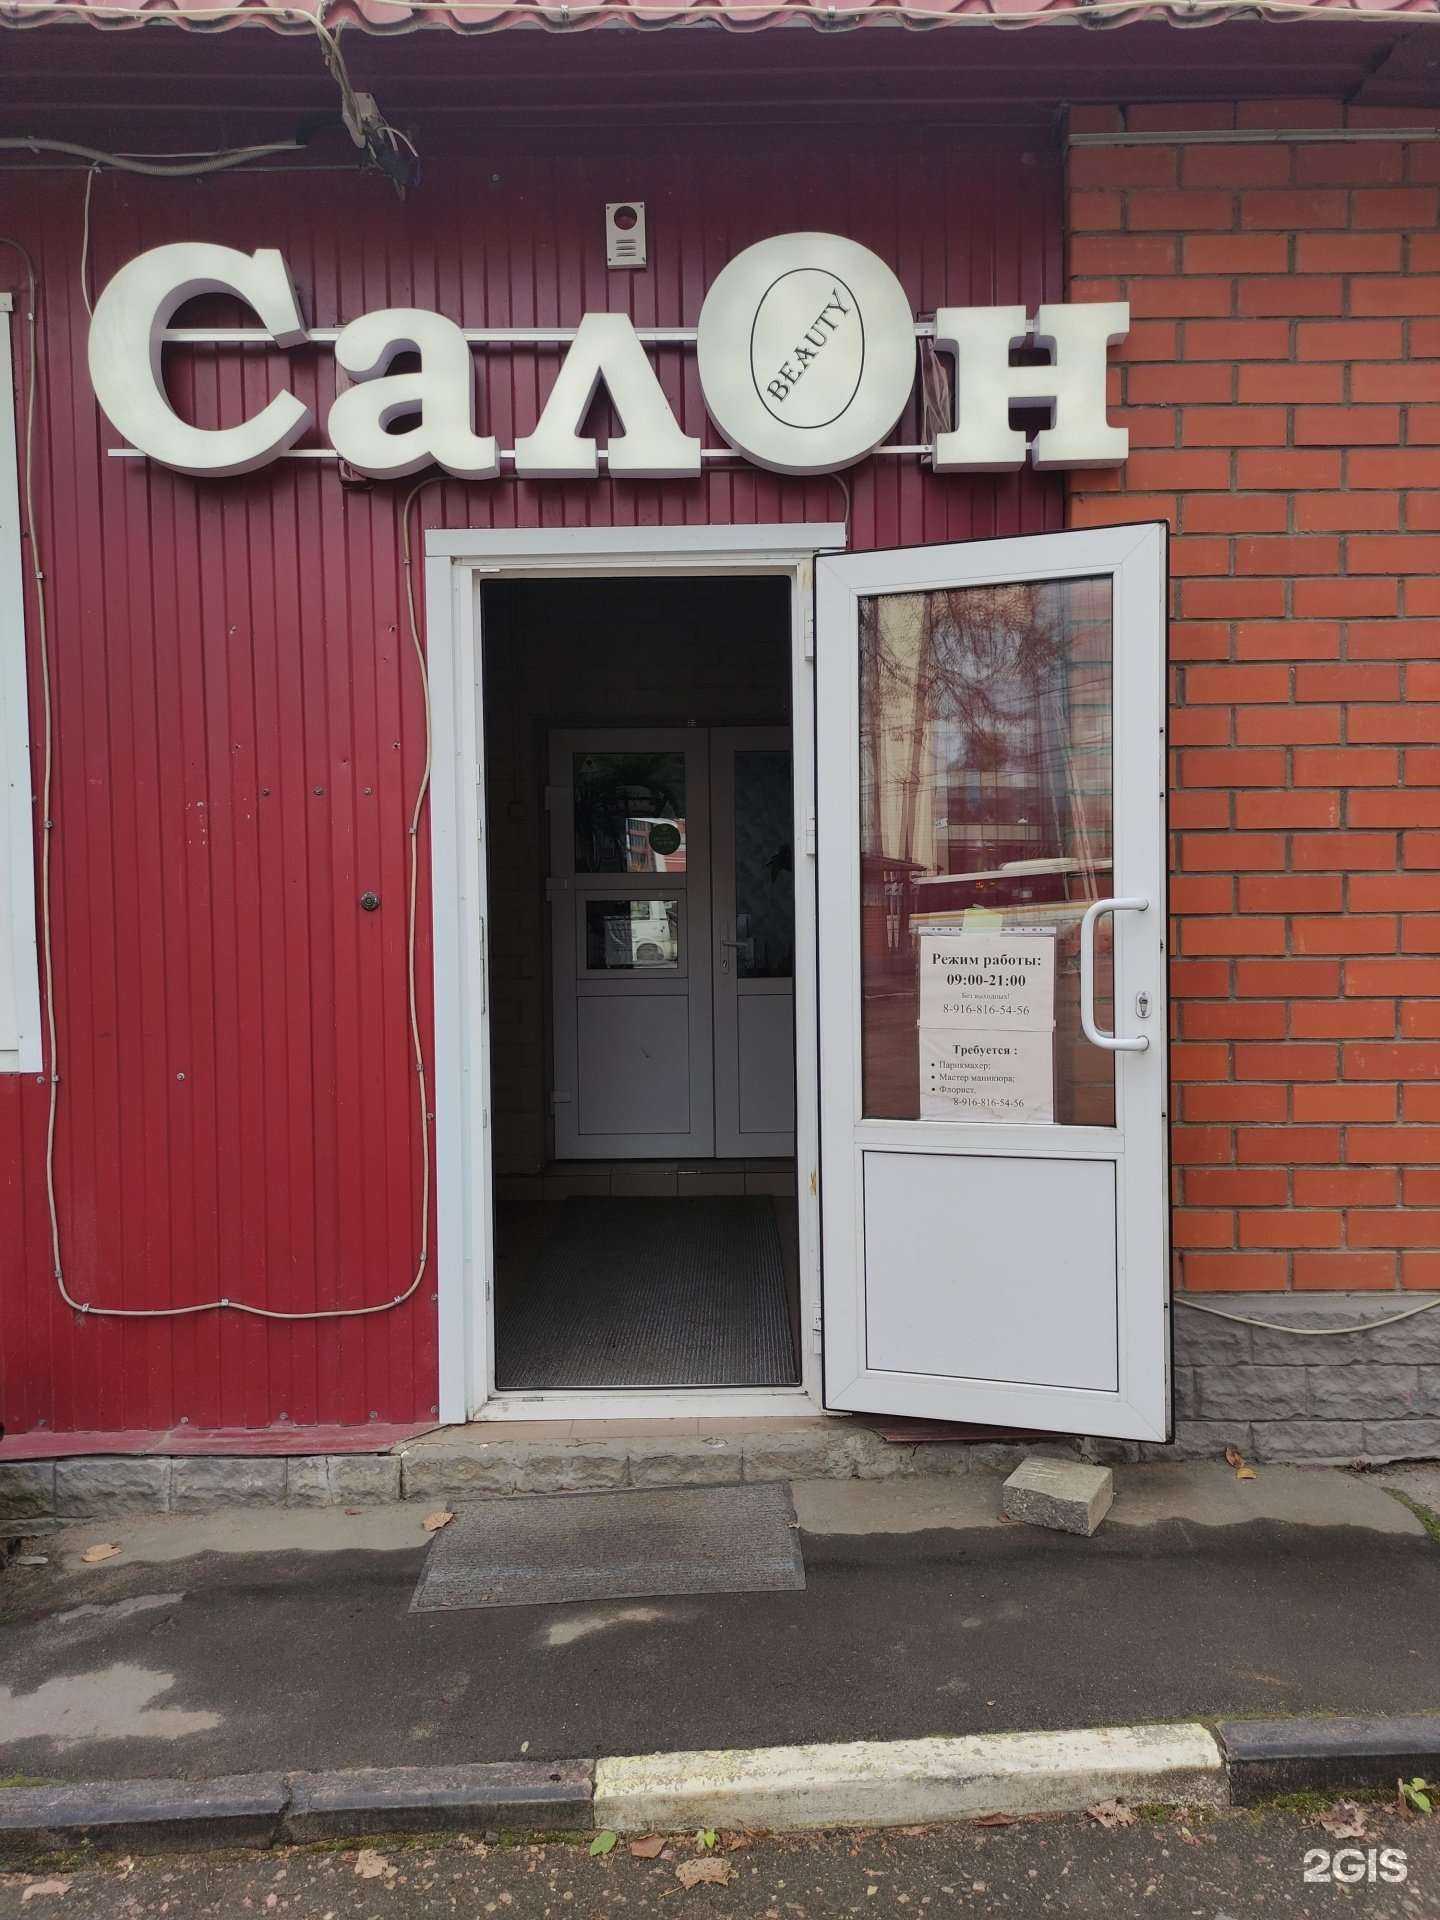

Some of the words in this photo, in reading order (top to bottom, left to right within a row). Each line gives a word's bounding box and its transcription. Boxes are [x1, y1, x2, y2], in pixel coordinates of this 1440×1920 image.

[767, 288, 851, 402] BEAUTY
[932, 953, 979, 965] Режим
[983, 954, 1041, 968] работы:
[946, 974, 1026, 987] 09:00-21:00
[943, 1003, 1030, 1015] 8-916-816-54-56
[952, 1044, 1010, 1056] Требуется
[939, 1073, 969, 1083] Мастер
[952, 1098, 1025, 1108] 8-916-816-54-56
